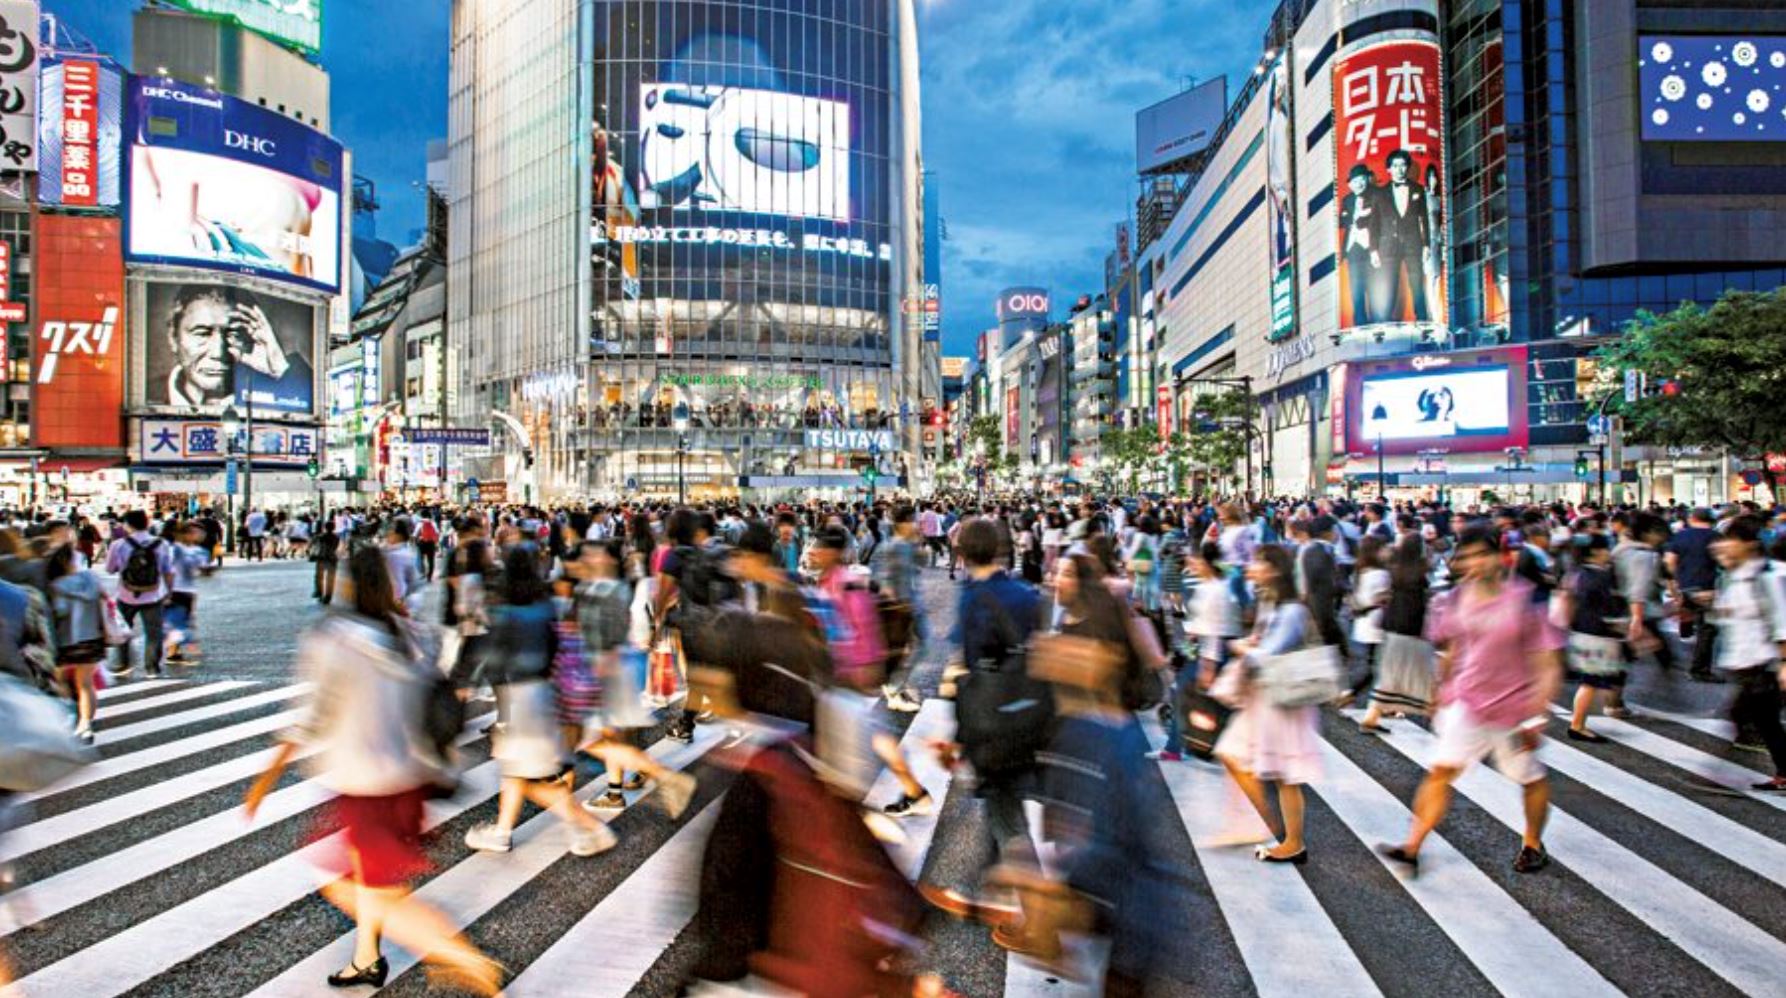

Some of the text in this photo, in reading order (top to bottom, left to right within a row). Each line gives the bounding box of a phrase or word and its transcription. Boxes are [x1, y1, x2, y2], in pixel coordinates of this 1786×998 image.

[142, 85, 170, 100] DHC
[1342, 61, 1426, 118] 日本
[63, 65, 93, 197] 三千里薬品
[224, 128, 277, 157] DHC
[1344, 108, 1440, 160] ダービー
[38, 306, 119, 384] クスリ
[808, 430, 891, 450] TSUTAYA
